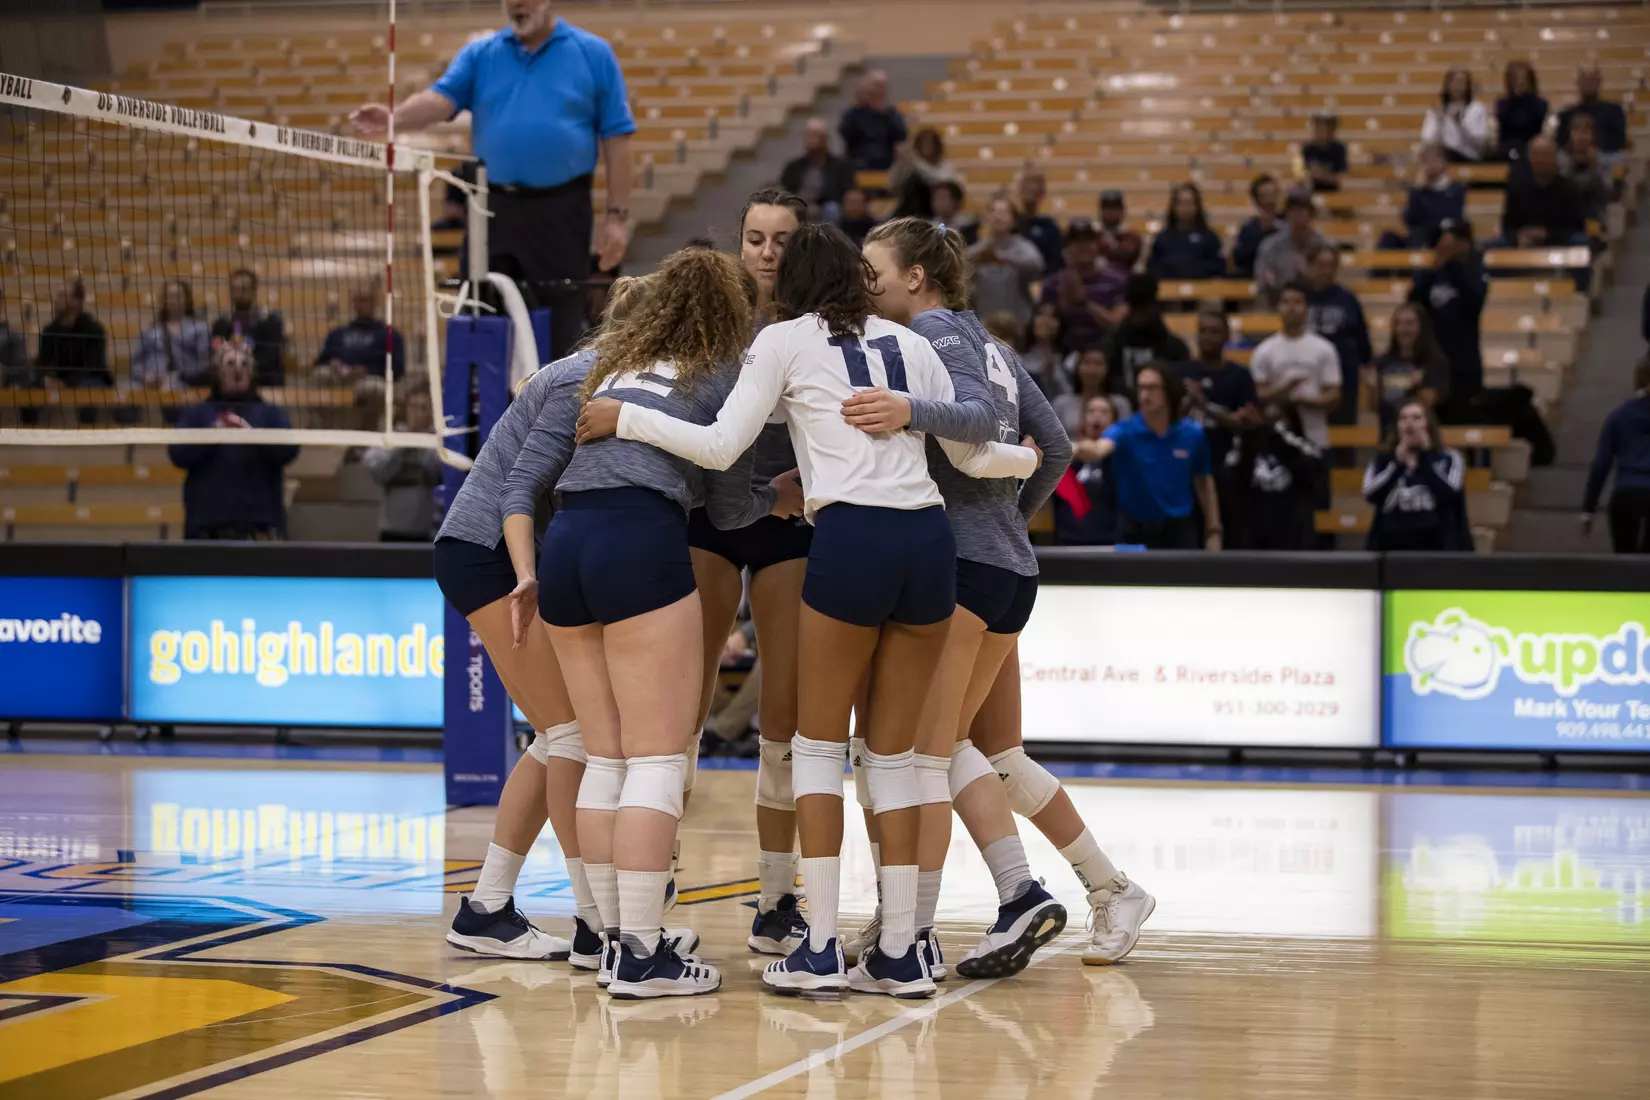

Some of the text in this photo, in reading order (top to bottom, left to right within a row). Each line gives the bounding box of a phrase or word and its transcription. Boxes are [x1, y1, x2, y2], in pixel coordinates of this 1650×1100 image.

[117, 95, 167, 123] RIVERSIDE
[171, 104, 226, 133] VOLLEYBALL
[932, 335, 961, 350] WAC
[826, 333, 910, 394] 11
[984, 342, 1019, 406] 4
[1021, 661, 1098, 683] Central
[1154, 664, 1167, 683] &
[1176, 664, 1273, 685] Riverside
[1281, 666, 1335, 686] Plaza
[1513, 698, 1568, 718] Mark
[1571, 699, 1620, 719] Your
